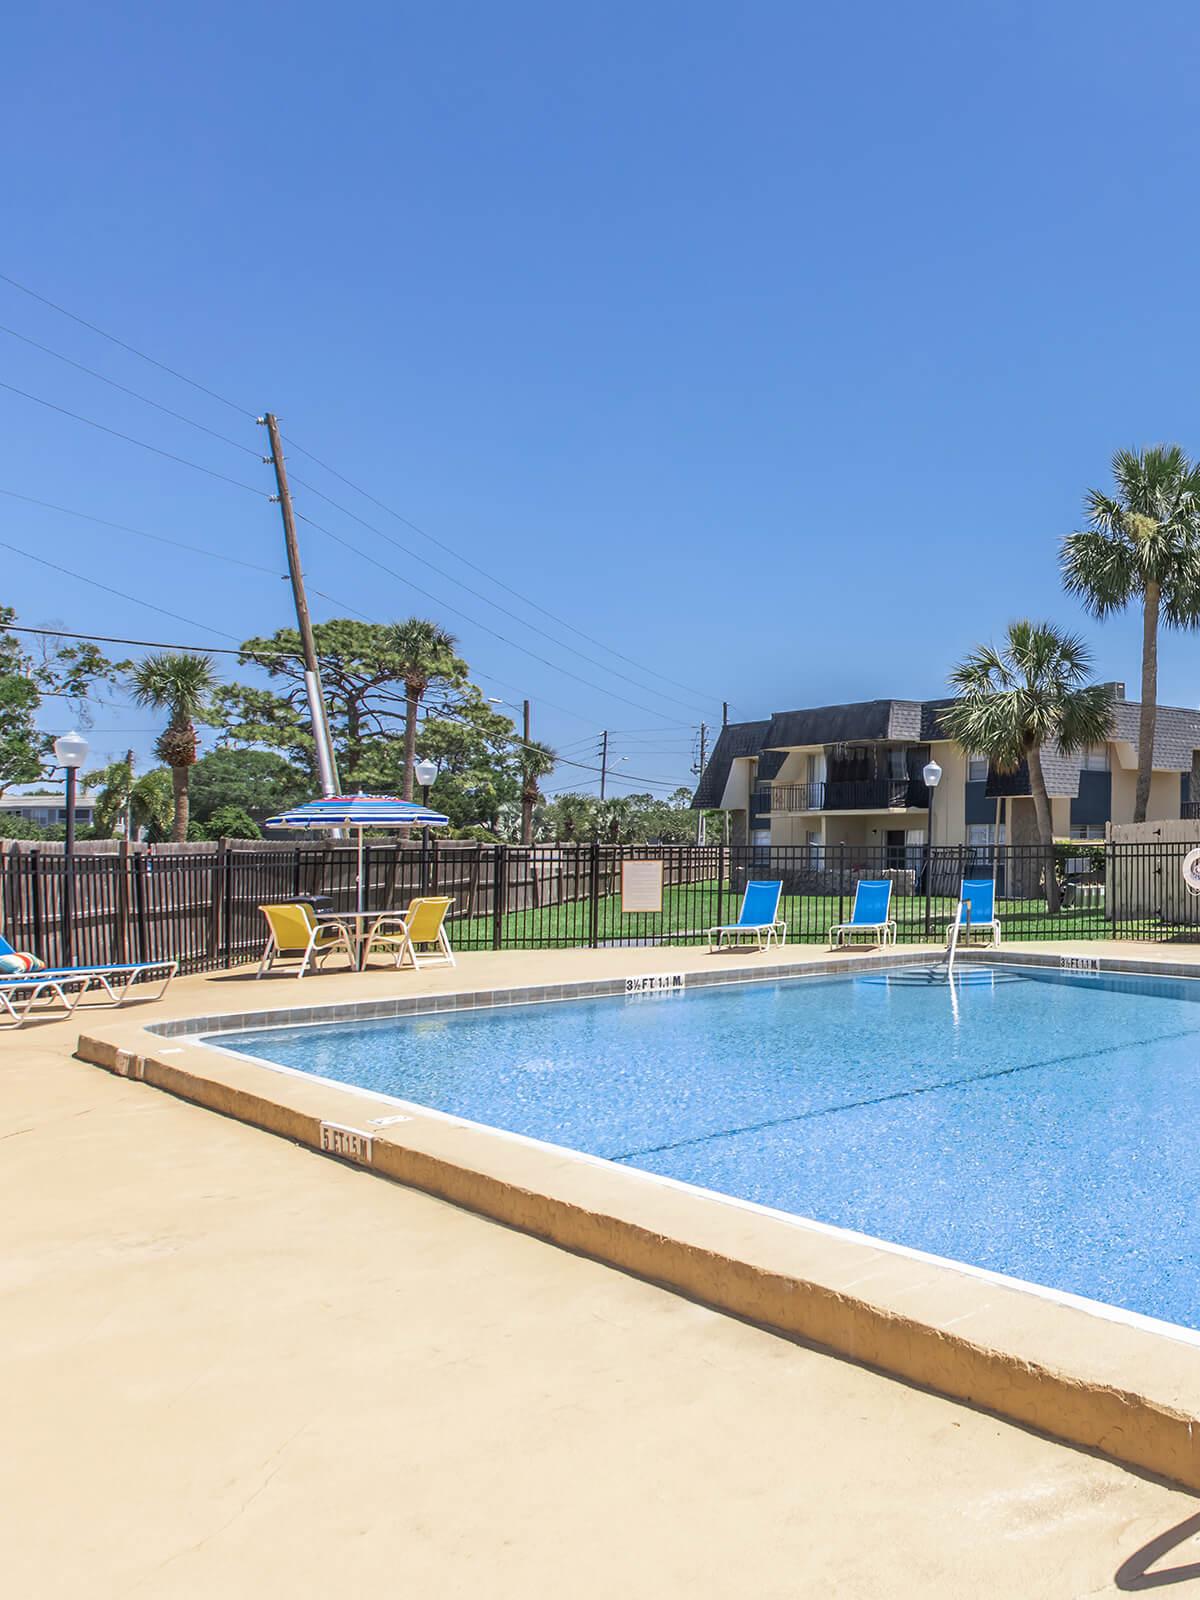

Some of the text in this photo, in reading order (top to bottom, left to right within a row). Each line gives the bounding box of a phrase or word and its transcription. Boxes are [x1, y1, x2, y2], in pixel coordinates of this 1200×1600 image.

[658, 976, 669, 988] 1.1
[672, 975, 683, 986] M.
[323, 1127, 330, 1151] 5
